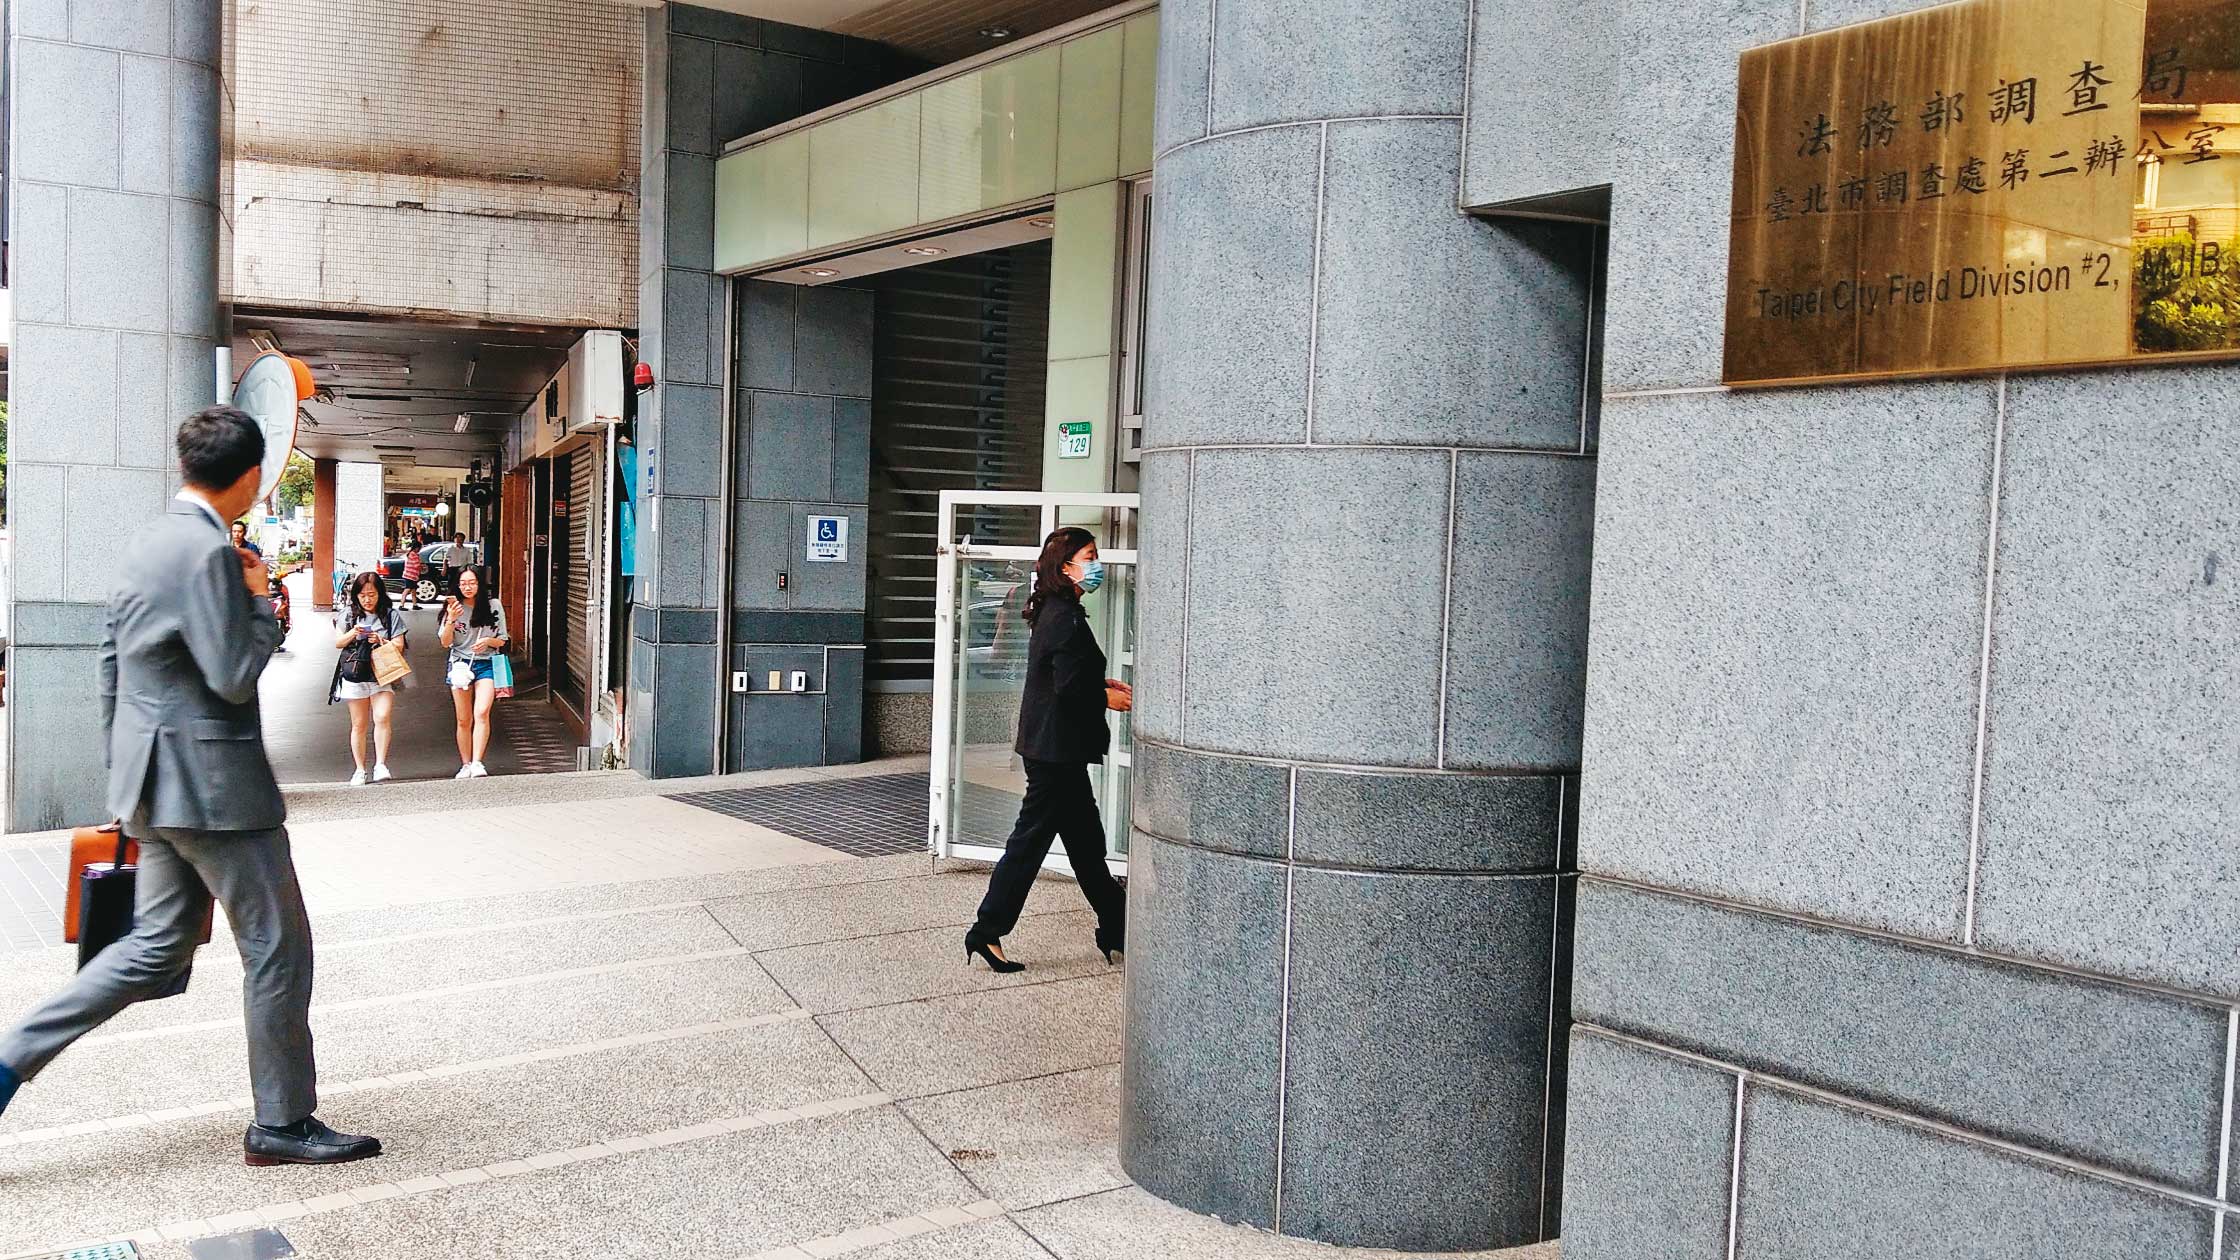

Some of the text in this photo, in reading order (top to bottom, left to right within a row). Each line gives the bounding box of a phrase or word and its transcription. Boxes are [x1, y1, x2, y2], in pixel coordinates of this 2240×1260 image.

[1797, 48, 2188, 158] 法務部調查局
[1766, 122, 2226, 224] 臺北市調查處第二辦公室
[1757, 287, 1824, 322] Taipei
[1832, 277, 1880, 316] City
[1888, 269, 1950, 306] Field
[1960, 261, 2070, 300] Division
[2081, 251, 2119, 292] #2,
[1069, 437, 1087, 453] 129
